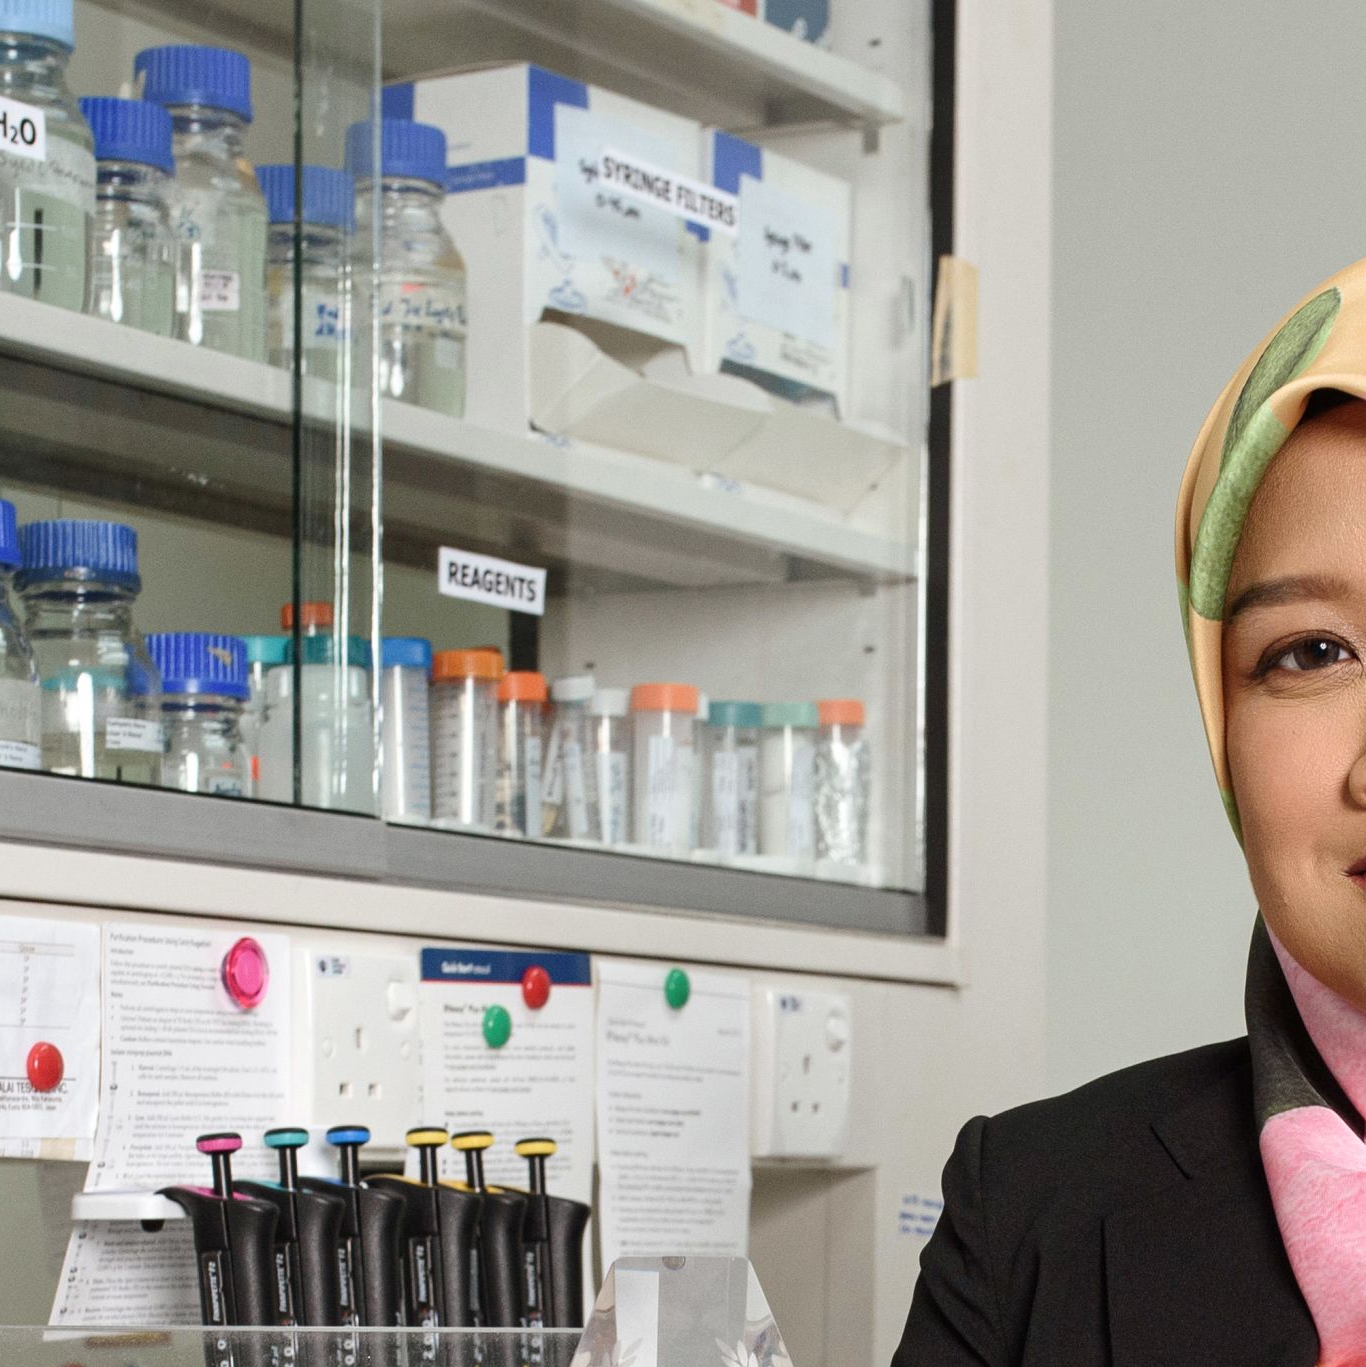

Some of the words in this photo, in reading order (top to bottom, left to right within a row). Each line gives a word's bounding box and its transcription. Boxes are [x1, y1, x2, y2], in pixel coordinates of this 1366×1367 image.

[602, 155, 672, 204] SYRINGE
[676, 185, 735, 227] FILTERS
[448, 561, 537, 603] REAGENTS
